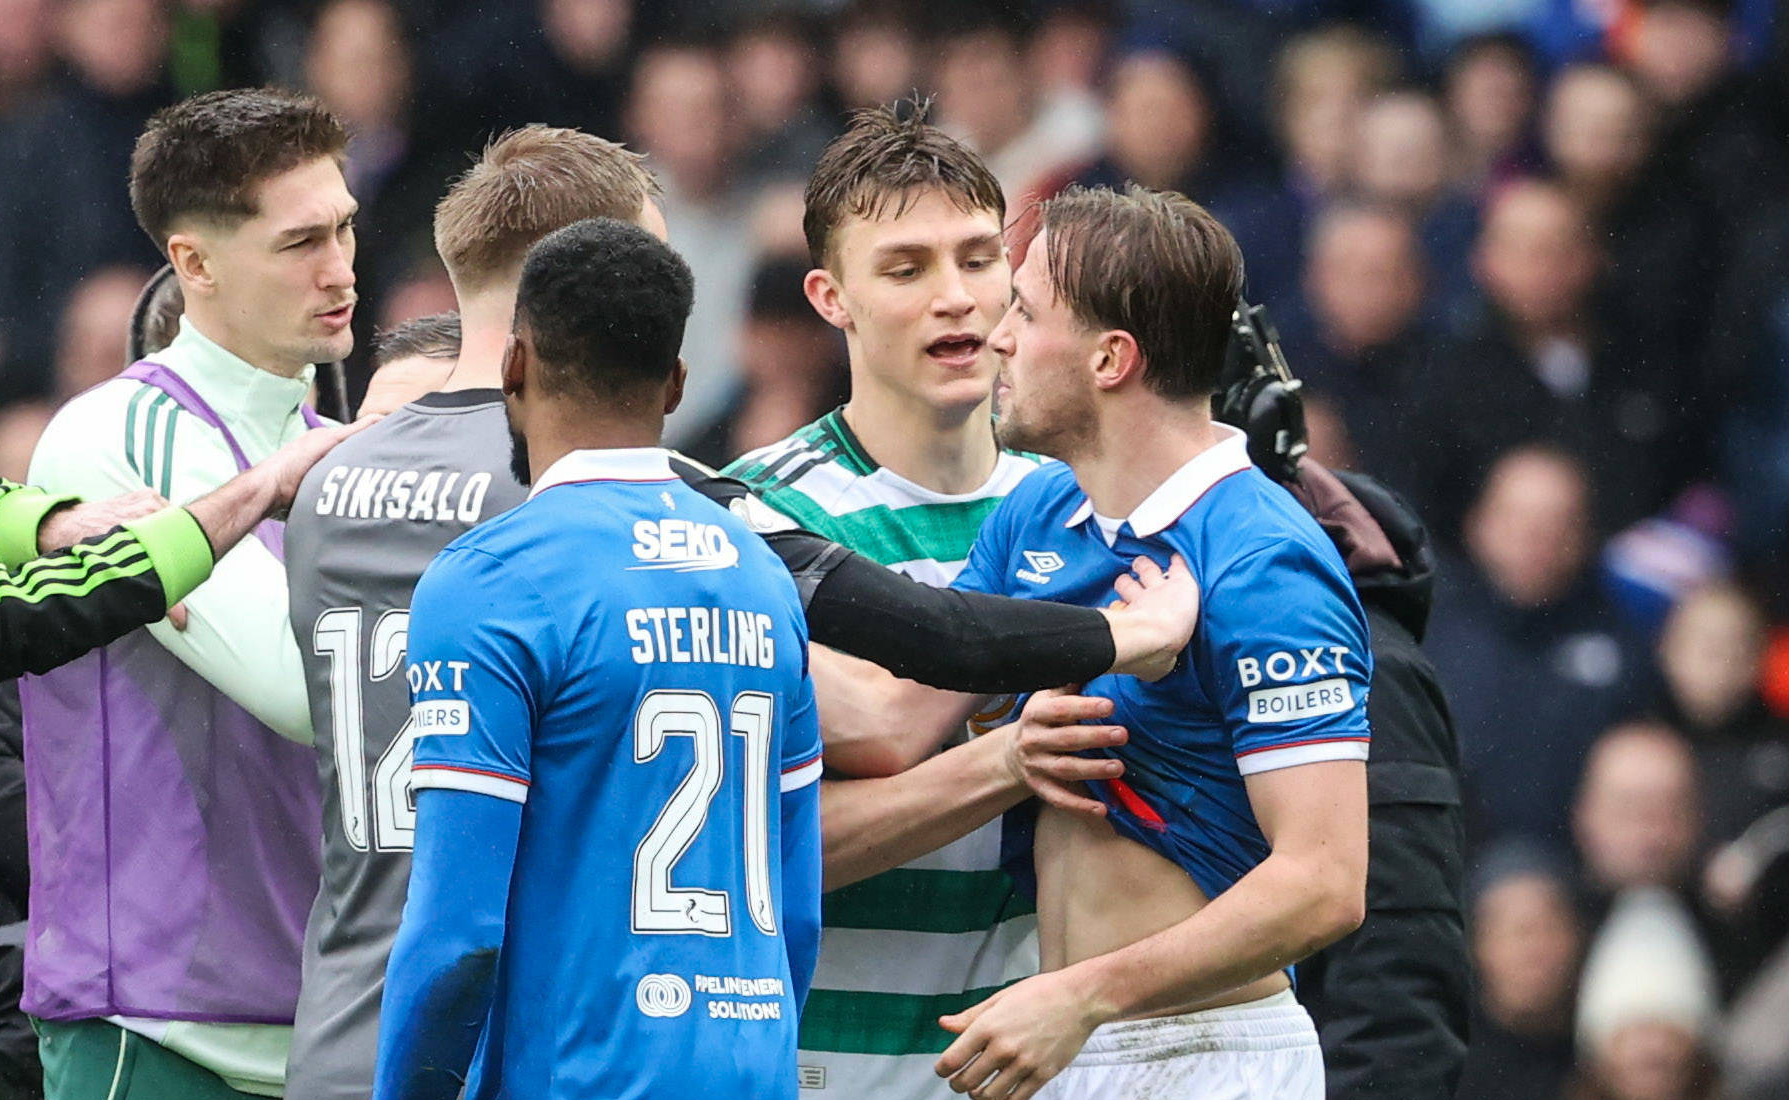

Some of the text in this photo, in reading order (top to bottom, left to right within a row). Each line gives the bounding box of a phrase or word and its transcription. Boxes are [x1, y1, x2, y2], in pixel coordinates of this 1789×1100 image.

[316, 465, 492, 522] SINISALO
[625, 606, 776, 669] STERLING
[406, 660, 470, 694] OXT
[1237, 646, 1350, 688] BOXT
[414, 708, 461, 729] ILERS
[1256, 687, 1344, 715] BOILERS
[630, 688, 778, 938] 21
